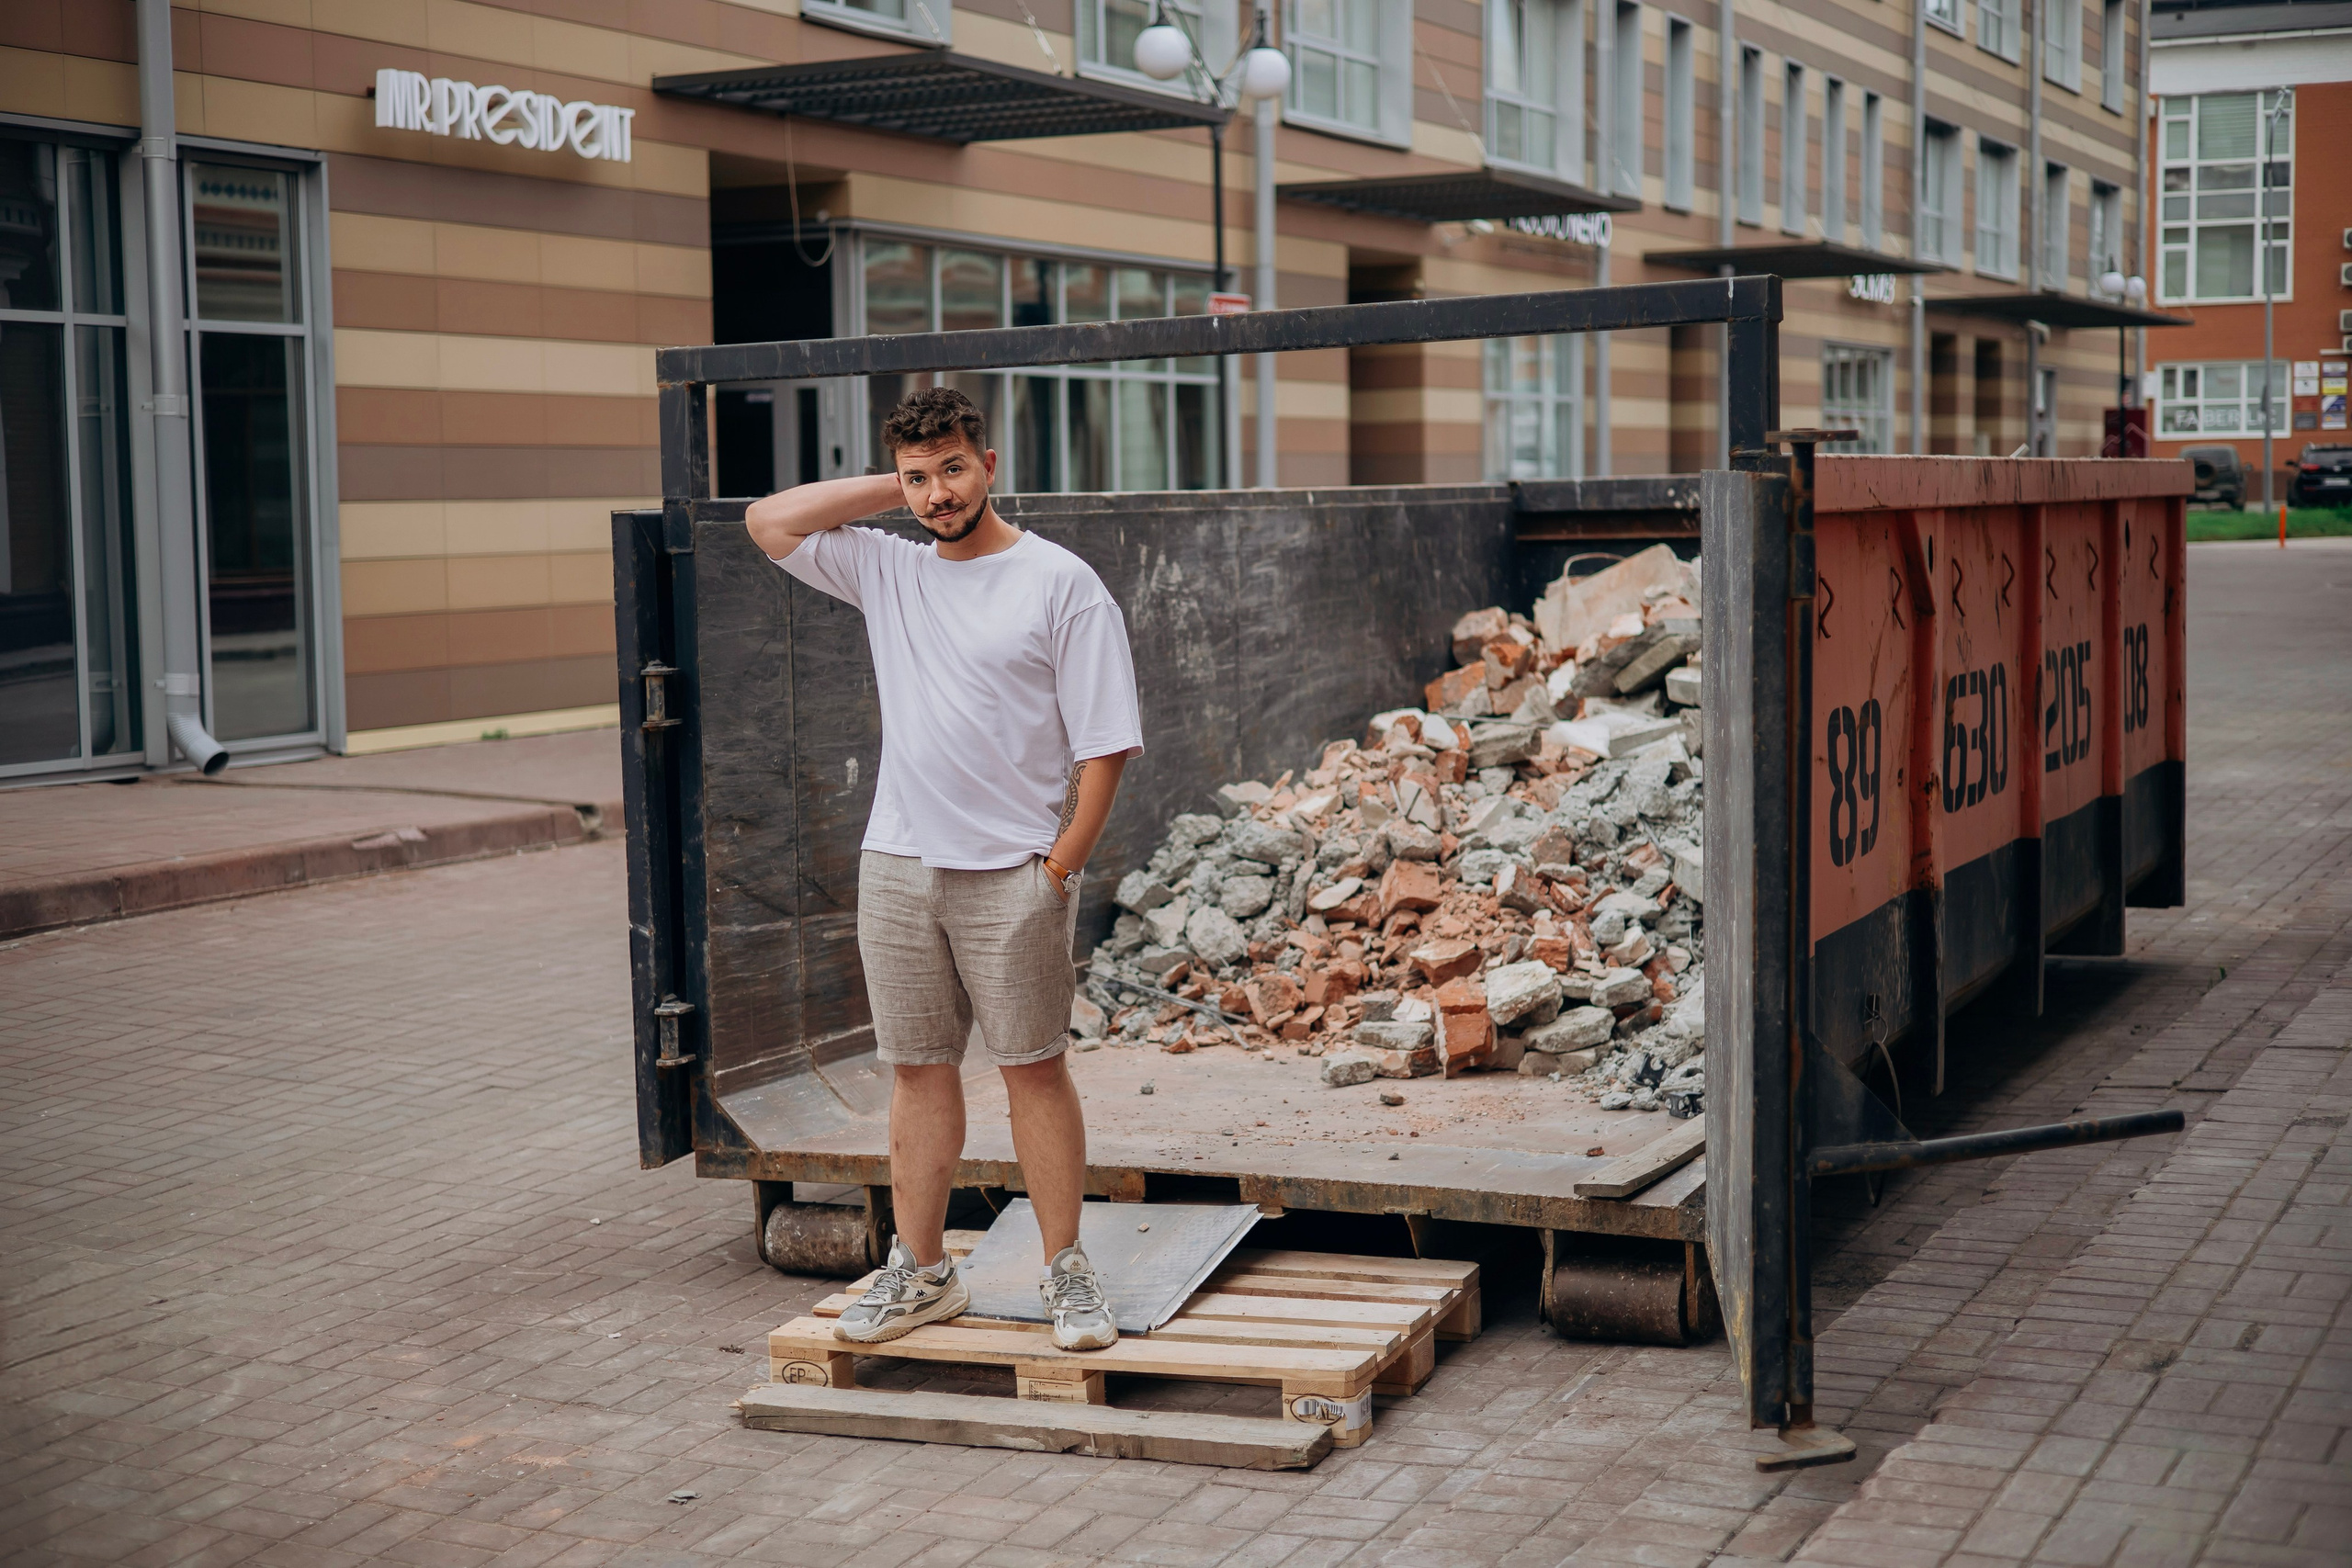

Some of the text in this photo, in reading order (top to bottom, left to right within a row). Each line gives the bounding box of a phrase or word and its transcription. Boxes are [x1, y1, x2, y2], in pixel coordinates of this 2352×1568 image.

[1827, 623, 2149, 867] 89 630 205 08
